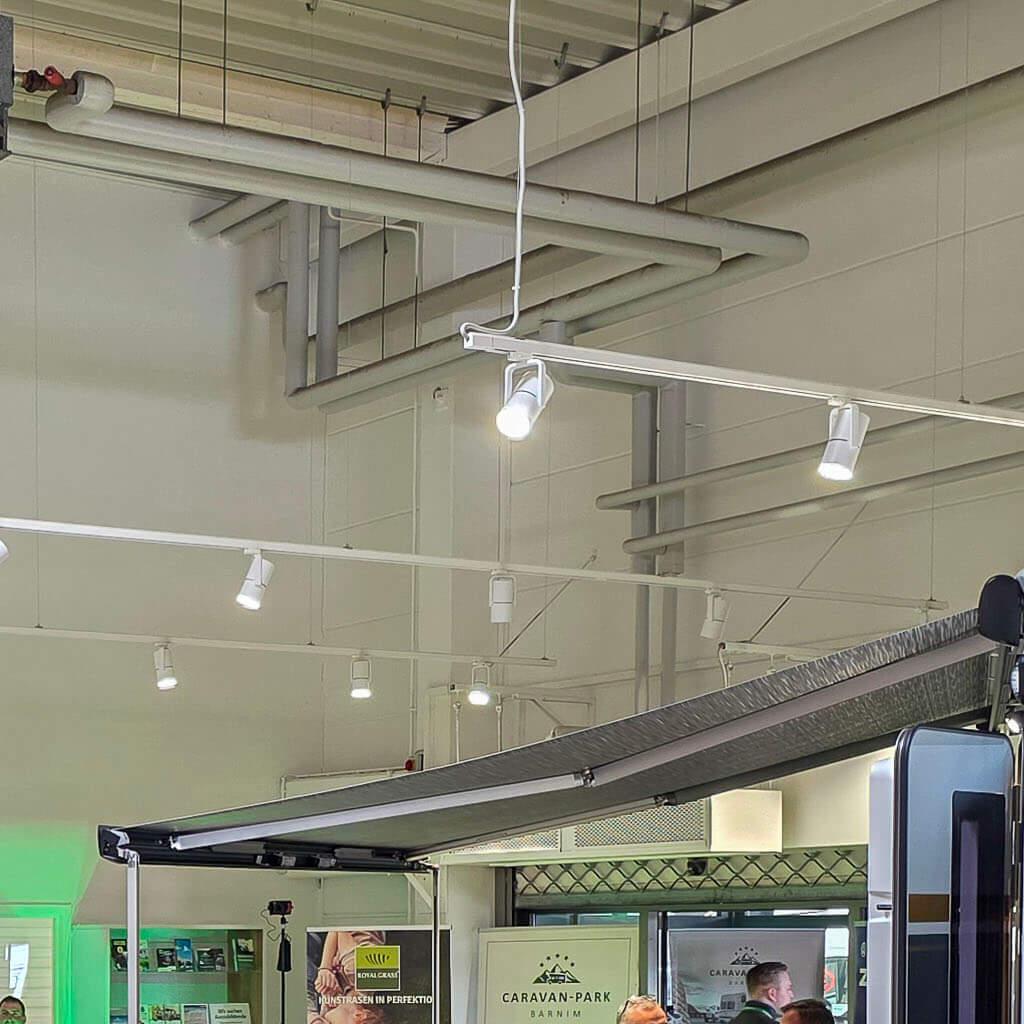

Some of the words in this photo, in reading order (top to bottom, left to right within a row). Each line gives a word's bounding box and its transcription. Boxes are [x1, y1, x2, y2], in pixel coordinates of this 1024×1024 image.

[318, 995, 374, 1004] KUNSTRASEN
[376, 995, 385, 1004] IN
[387, 995, 433, 1004] PERFEKTIO
[502, 991, 611, 1003] CARAVAN-PARK
[530, 1010, 581, 1018] BARNIM
